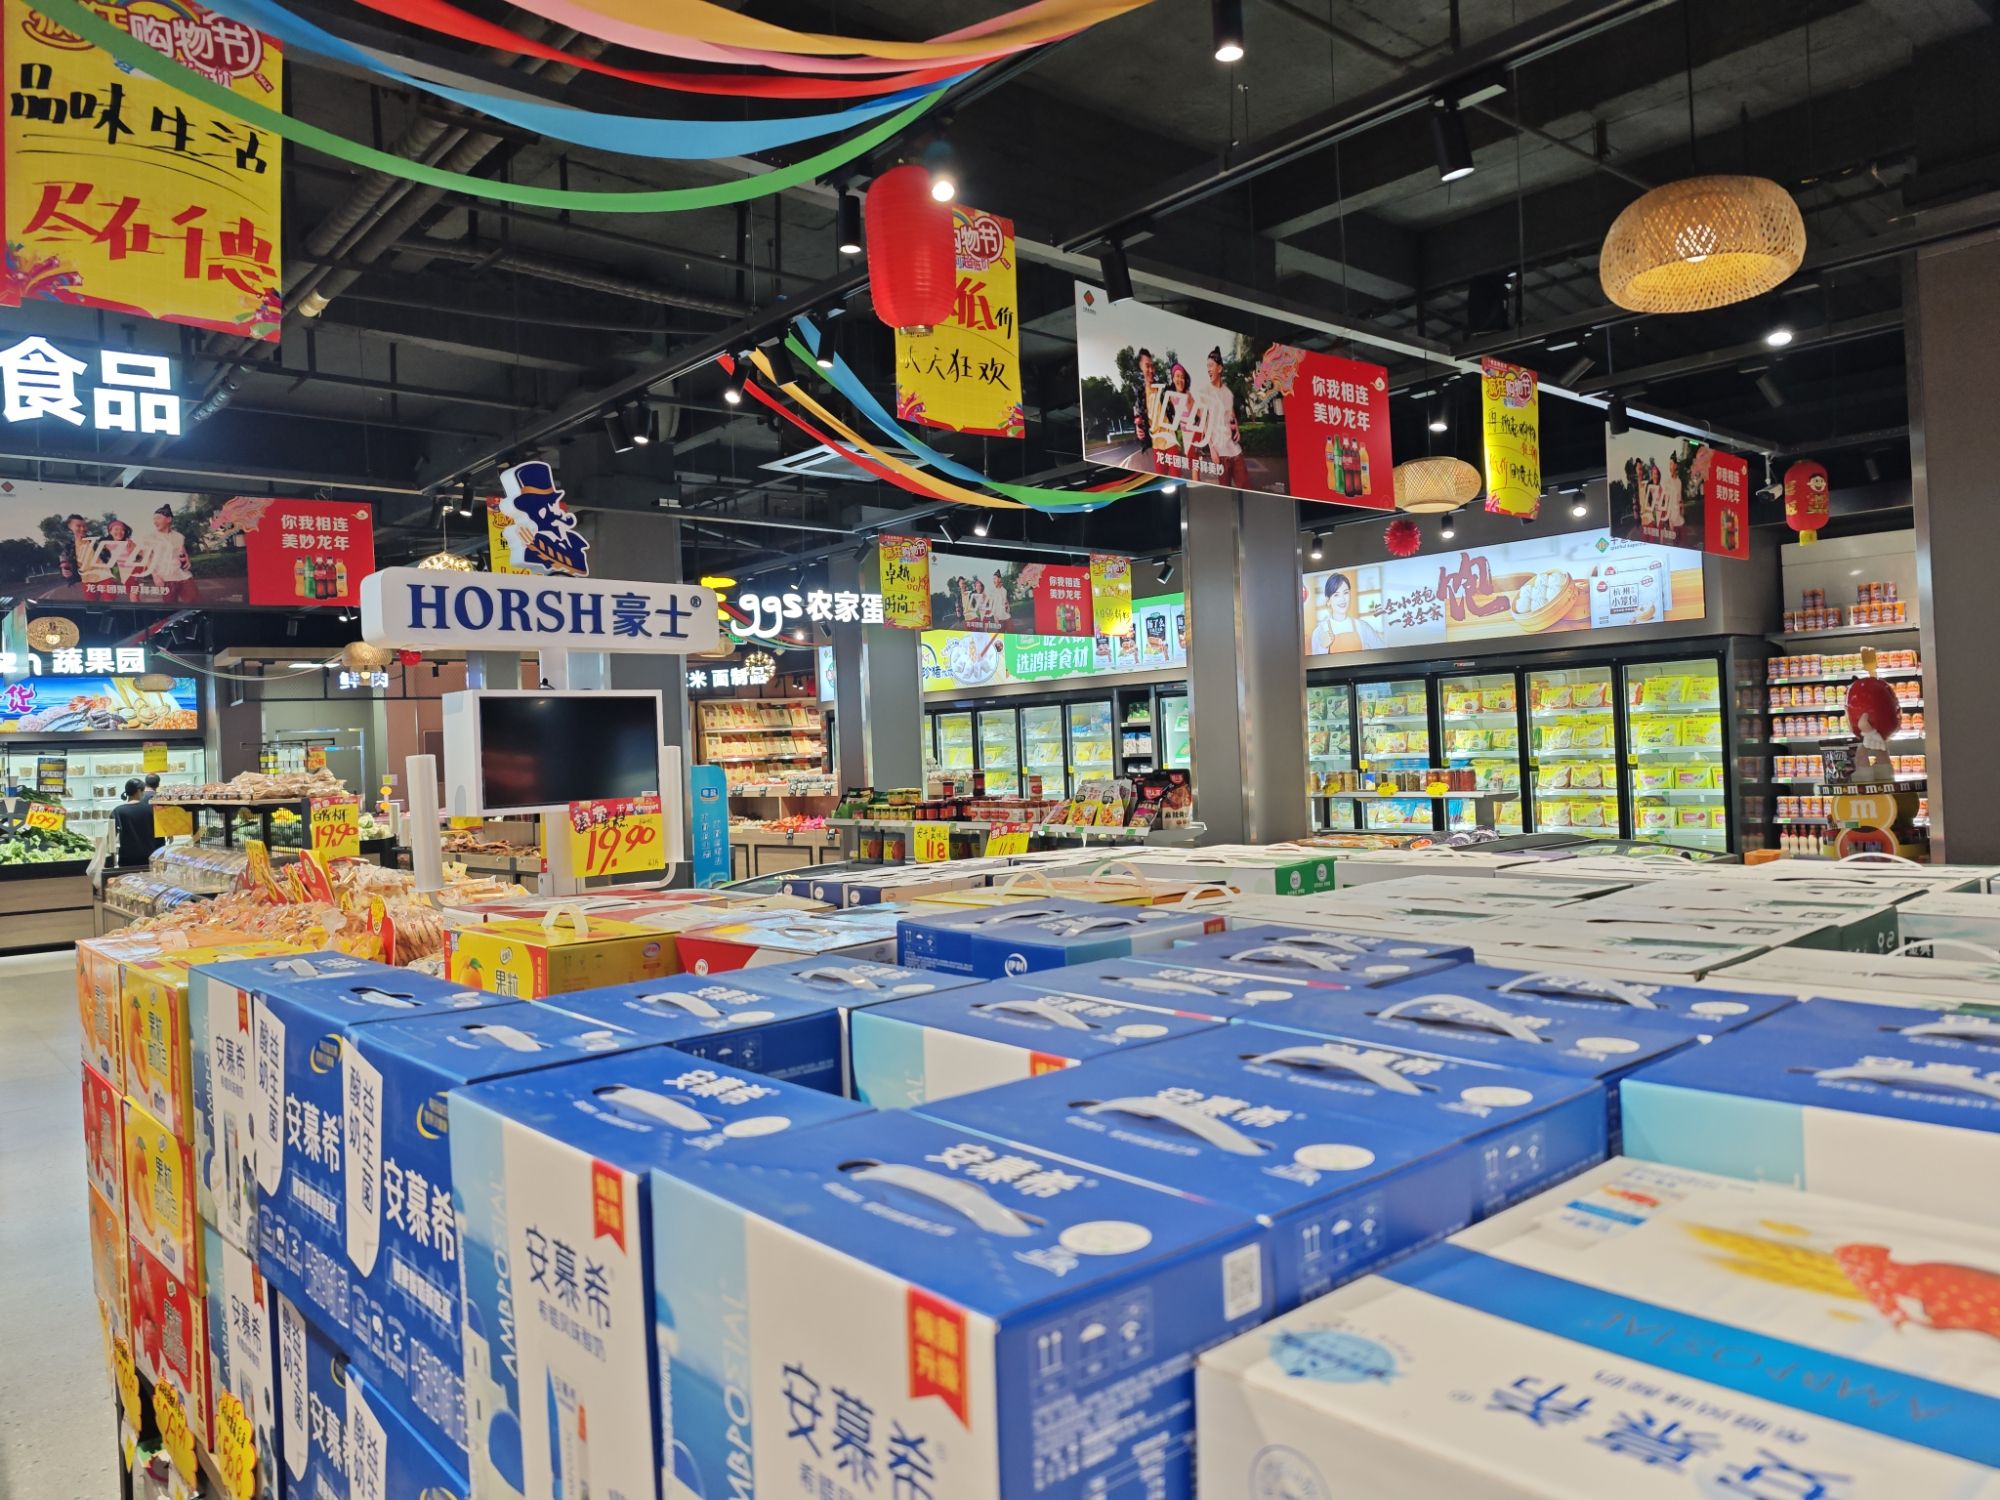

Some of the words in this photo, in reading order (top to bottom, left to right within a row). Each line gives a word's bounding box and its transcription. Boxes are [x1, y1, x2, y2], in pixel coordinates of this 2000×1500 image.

[0, 336, 181, 436] 食品
[1312, 374, 1370, 407] 你我相连
[1313, 402, 1371, 432] 美妙龙年
[281, 514, 349, 532] 你我相连
[281, 533, 350, 551] 美妙龙年
[885, 562, 911, 585] 卓越
[1437, 551, 1510, 622] 饱
[407, 584, 605, 634] HORSH
[611, 592, 693, 639] 豪士
[806, 589, 885, 625] 农家蛋
[885, 593, 909, 614] 时尚
[52, 647, 146, 674] 蔬果园
[712, 666, 767, 688] 面制品
[1016, 647, 1089, 674] 选鸿津食材
[0, 683, 36, 714] 货
[1850, 799, 1878, 819] m
[586, 824, 656, 876] 19.90
[496, 969, 519, 997] 果粒
[663, 1069, 773, 1106] 安慕希
[286, 1092, 341, 1174] 安慕希
[925, 1143, 1086, 1198] 安慕希
[383, 1157, 456, 1263] 安慕希
[526, 1224, 612, 1329] 安慕希
[232, 1293, 262, 1353] 安慕希
[783, 1361, 935, 1500] 安慕希
